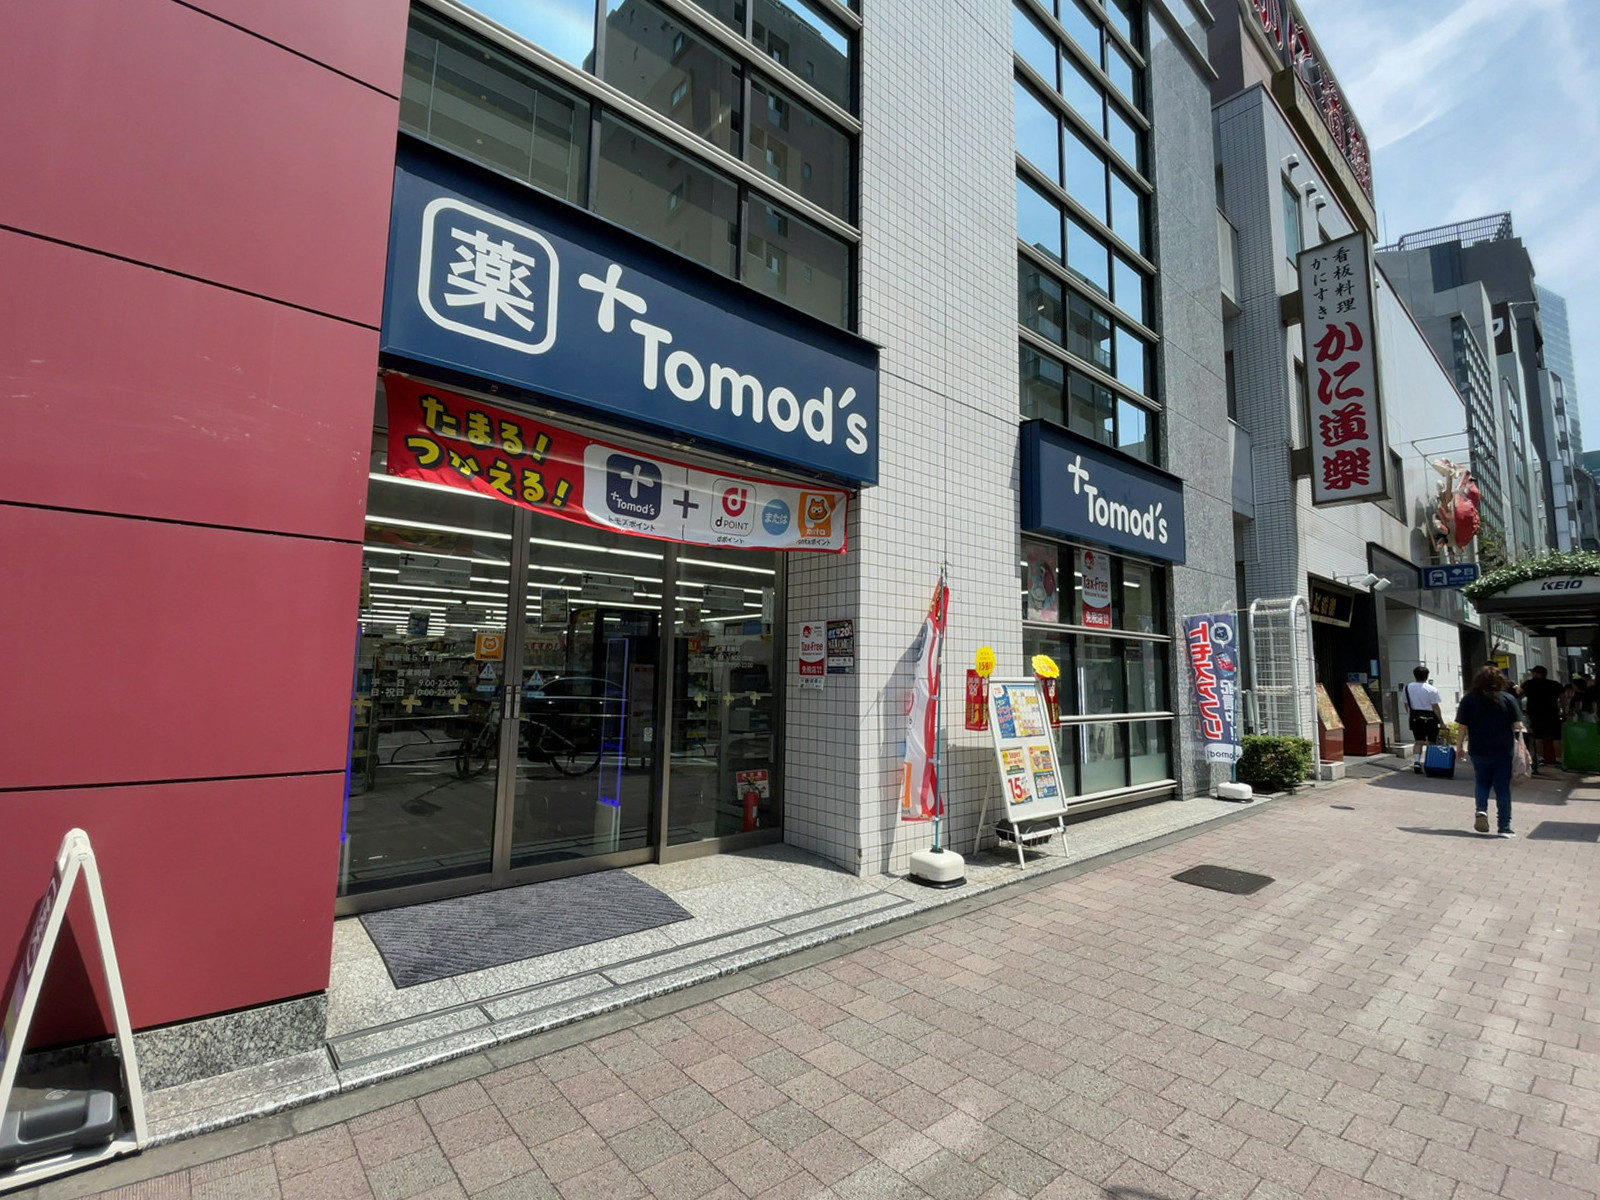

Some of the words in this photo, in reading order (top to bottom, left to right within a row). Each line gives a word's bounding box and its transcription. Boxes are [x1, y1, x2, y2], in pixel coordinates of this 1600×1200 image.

[443, 227, 536, 333] 薬
[1310, 257, 1329, 321] かにすき
[1332, 246, 1357, 315] 看板料理
[630, 319, 869, 456] Tomod's
[421, 396, 551, 464] たまる!
[607, 515, 656, 532] トモズポイント
[616, 497, 656, 516] Tomod's
[723, 520, 750, 531] POINT
[764, 511, 788, 525] または
[1083, 483, 1168, 545] Tomod's
[1541, 580, 1583, 591] KEIO
